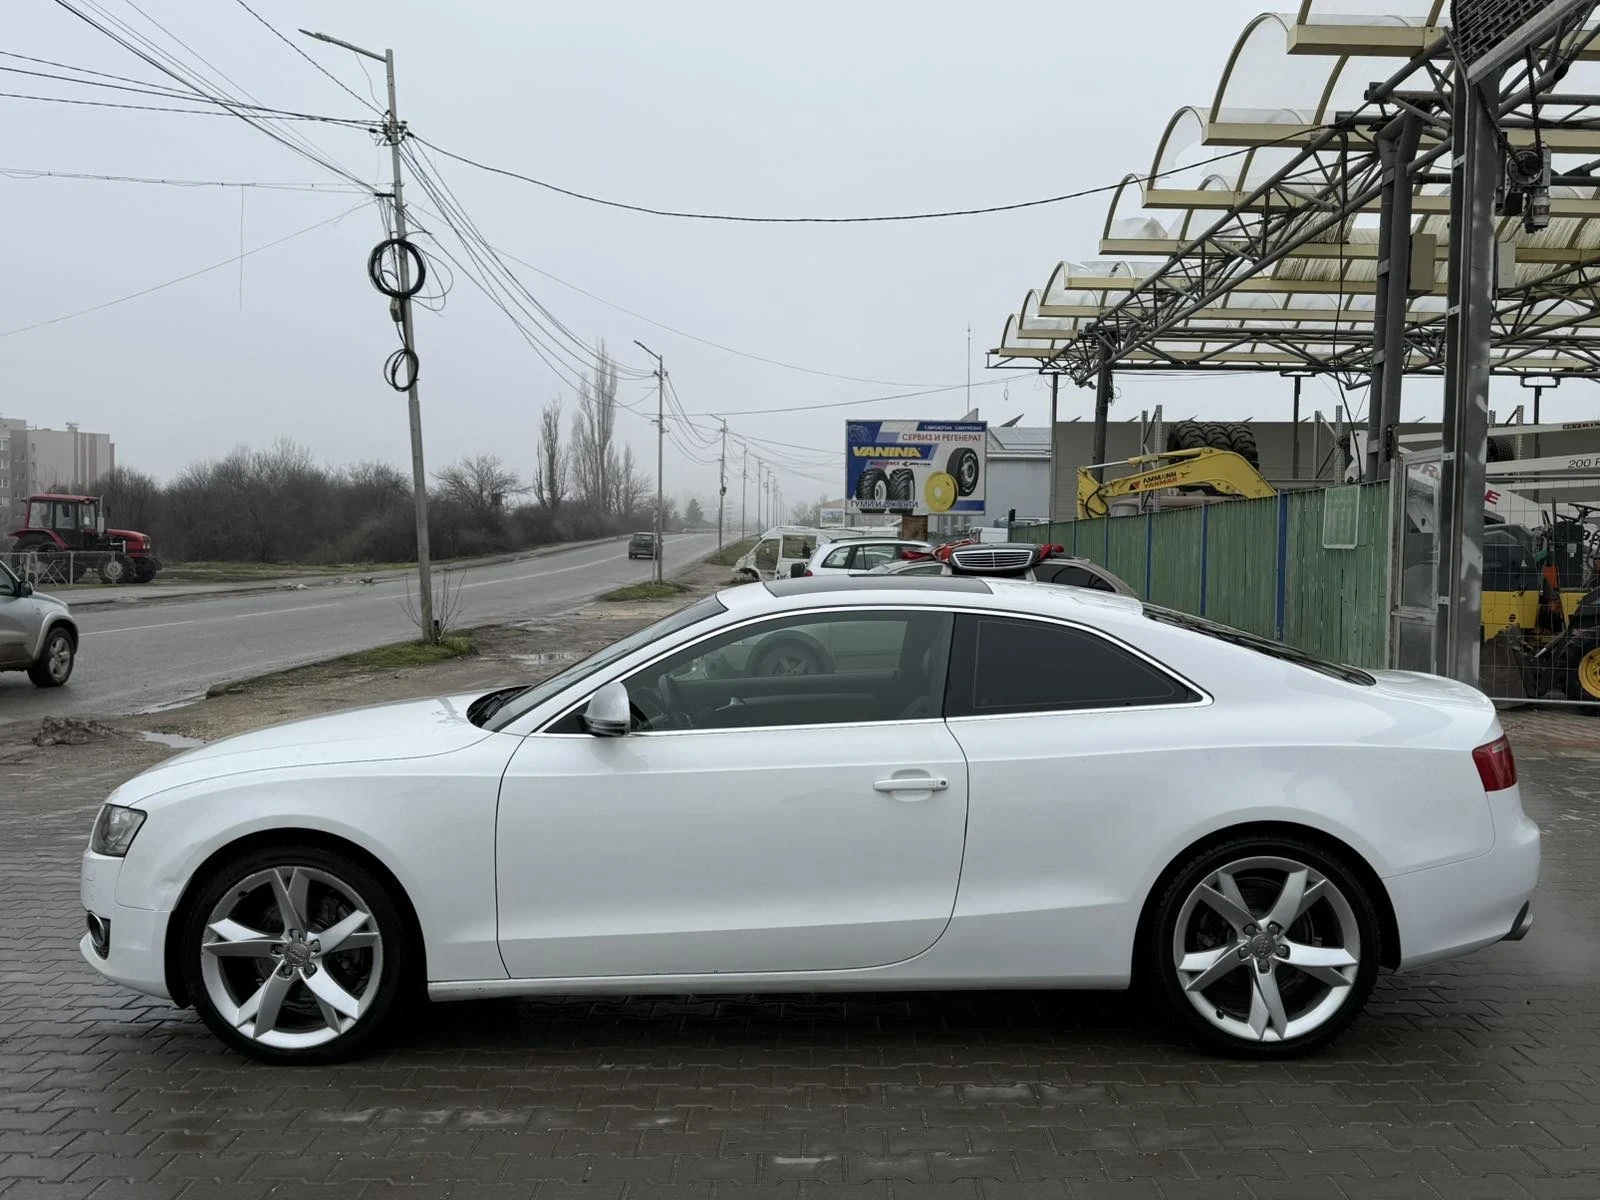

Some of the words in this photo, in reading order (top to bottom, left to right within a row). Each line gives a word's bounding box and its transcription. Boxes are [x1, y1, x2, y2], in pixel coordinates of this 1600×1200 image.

[902, 433, 933, 441] СЕРВИЗ
[942, 434, 982, 442] РЕГЕНЕРАТ
[852, 446, 922, 457] VANINA
[1567, 458, 1592, 469] 200
[1143, 471, 1177, 483] AMMANN
[1143, 477, 1178, 488] YANMAR
[850, 500, 873, 508] ГУМИ
